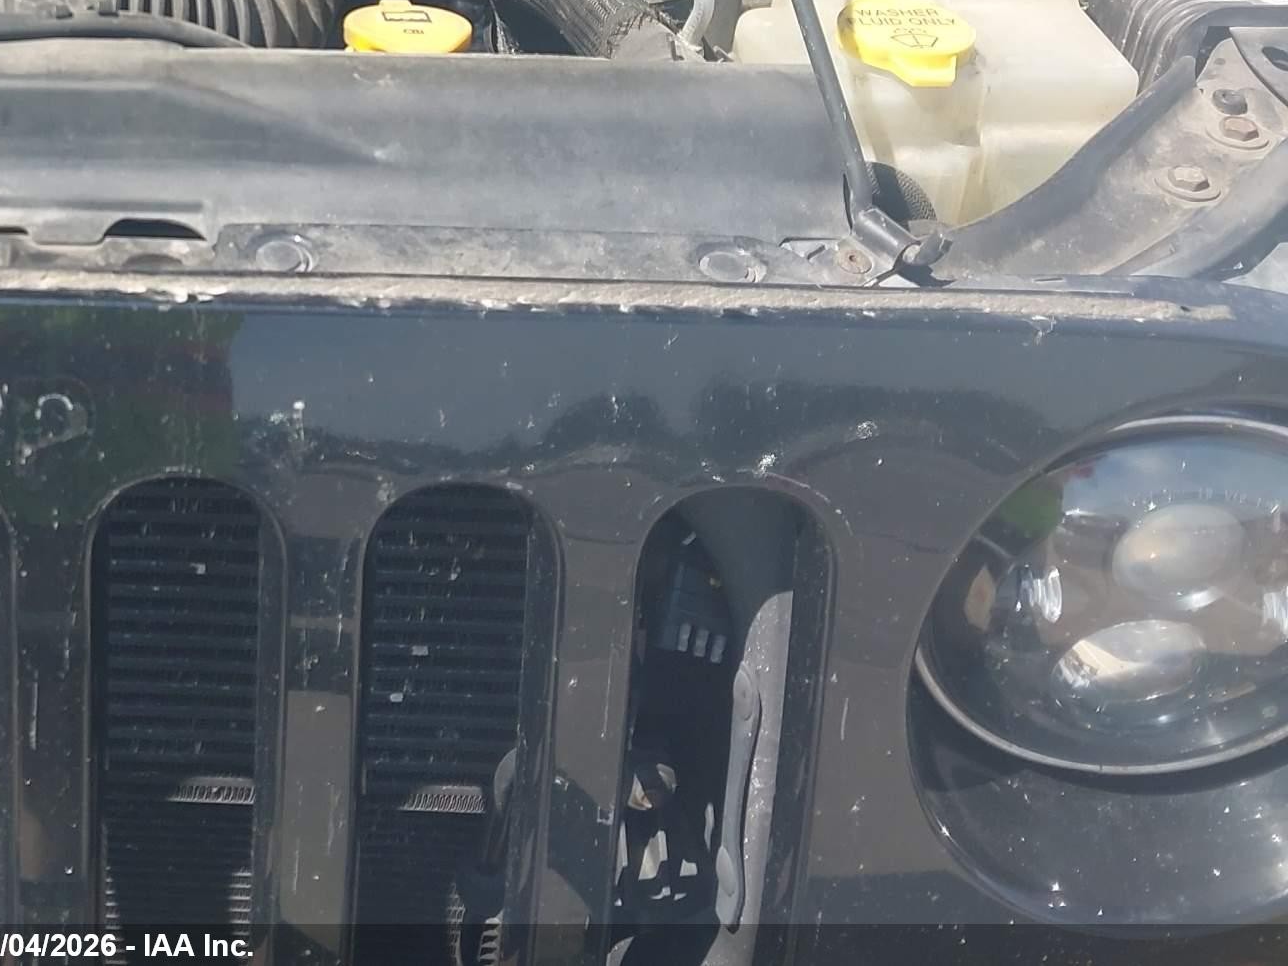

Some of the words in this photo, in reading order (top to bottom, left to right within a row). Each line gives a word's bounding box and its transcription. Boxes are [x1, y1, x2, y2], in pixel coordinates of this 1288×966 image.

[853, 8, 939, 17] WASHER
[847, 17, 903, 26] FLUID
[908, 17, 956, 26] ONLY
